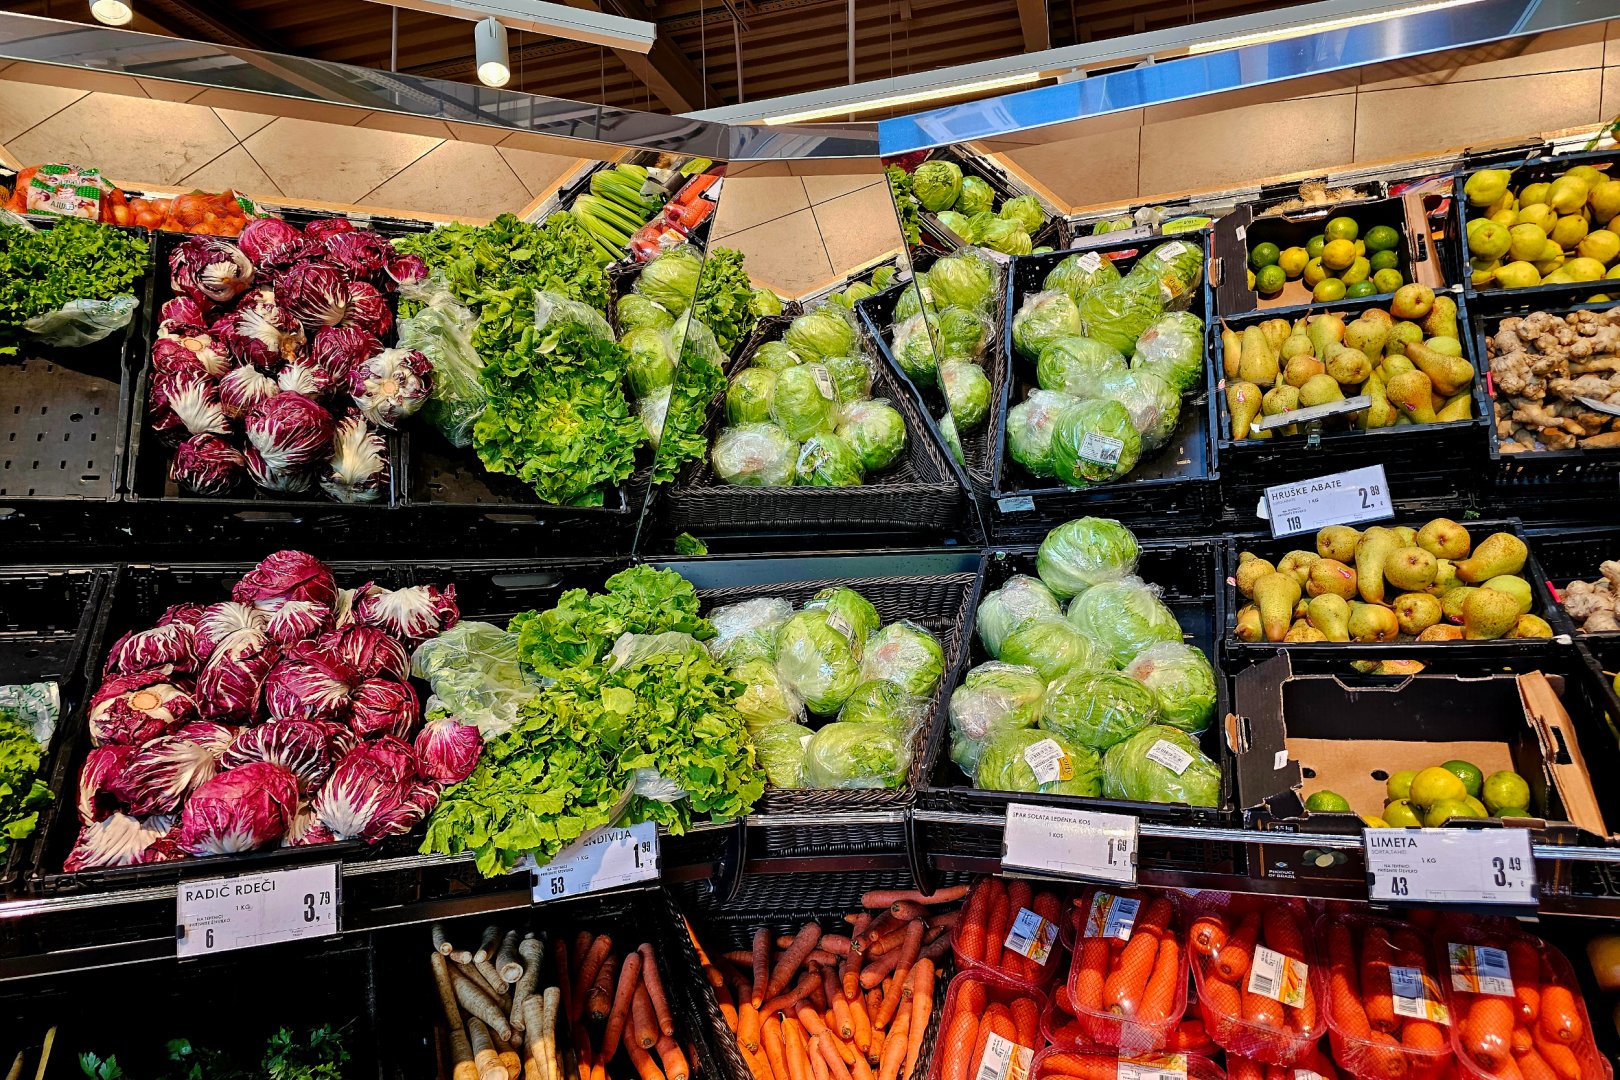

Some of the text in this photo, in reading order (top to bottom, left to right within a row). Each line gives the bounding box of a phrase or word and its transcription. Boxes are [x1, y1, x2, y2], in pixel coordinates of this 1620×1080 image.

[1272, 486, 1308, 501] HRUŠKE
[1310, 480, 1342, 493] ABATE
[1286, 516, 1302, 531] 119
[1051, 816, 1077, 824] LEDENKA
[1371, 837, 1418, 848] LIMETA
[634, 841, 651, 868] 1,99
[1492, 856, 1521, 888] 3,49
[186, 885, 230, 902] RADIČ
[236, 878, 276, 896] RDEČI
[551, 876, 564, 895] 53
[1391, 877, 1408, 896] 43
[303, 891, 330, 922] 3,79
[206, 929, 213, 948] 6
